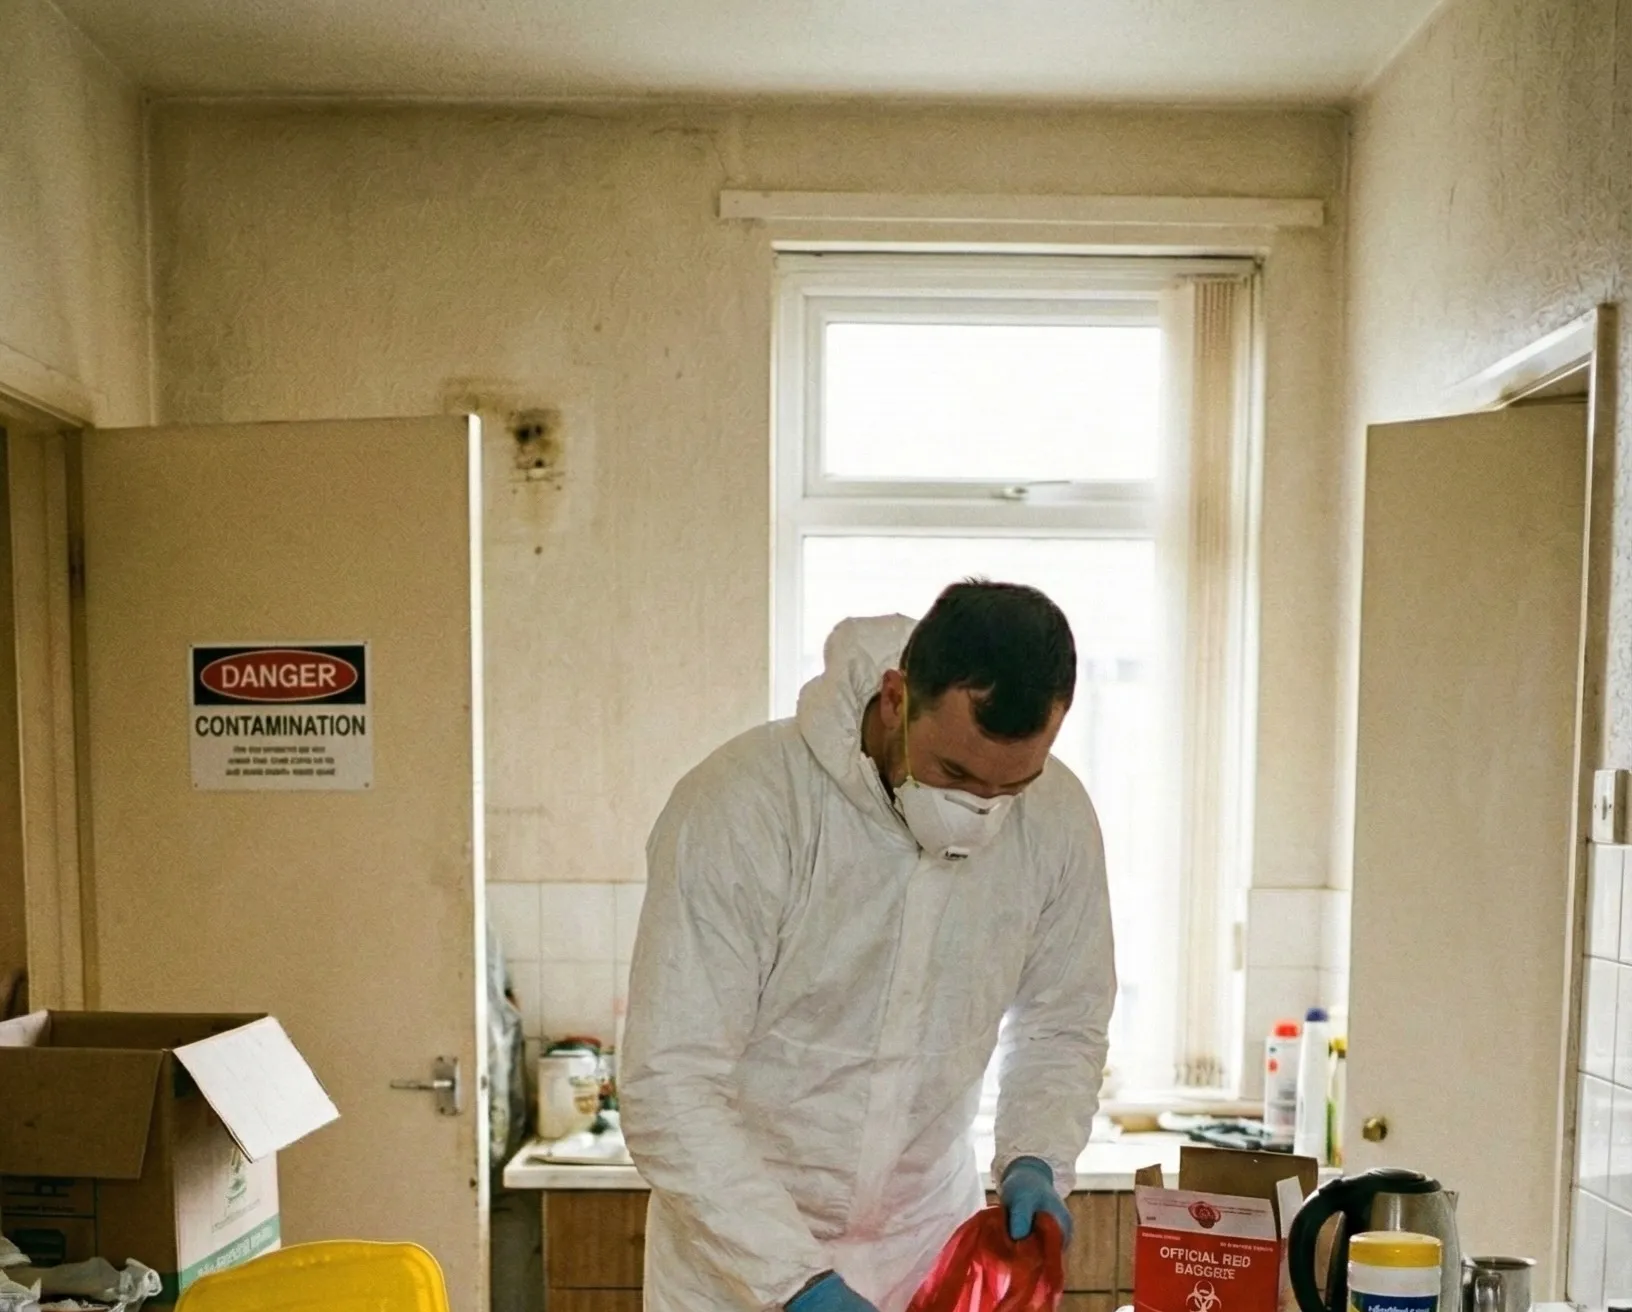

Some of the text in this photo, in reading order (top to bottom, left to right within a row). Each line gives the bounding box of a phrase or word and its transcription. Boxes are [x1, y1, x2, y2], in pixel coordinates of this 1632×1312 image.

[221, 664, 337, 689] DANGER
[195, 715, 366, 737] CONTAMINATION
[1222, 1253, 1251, 1269] RED
